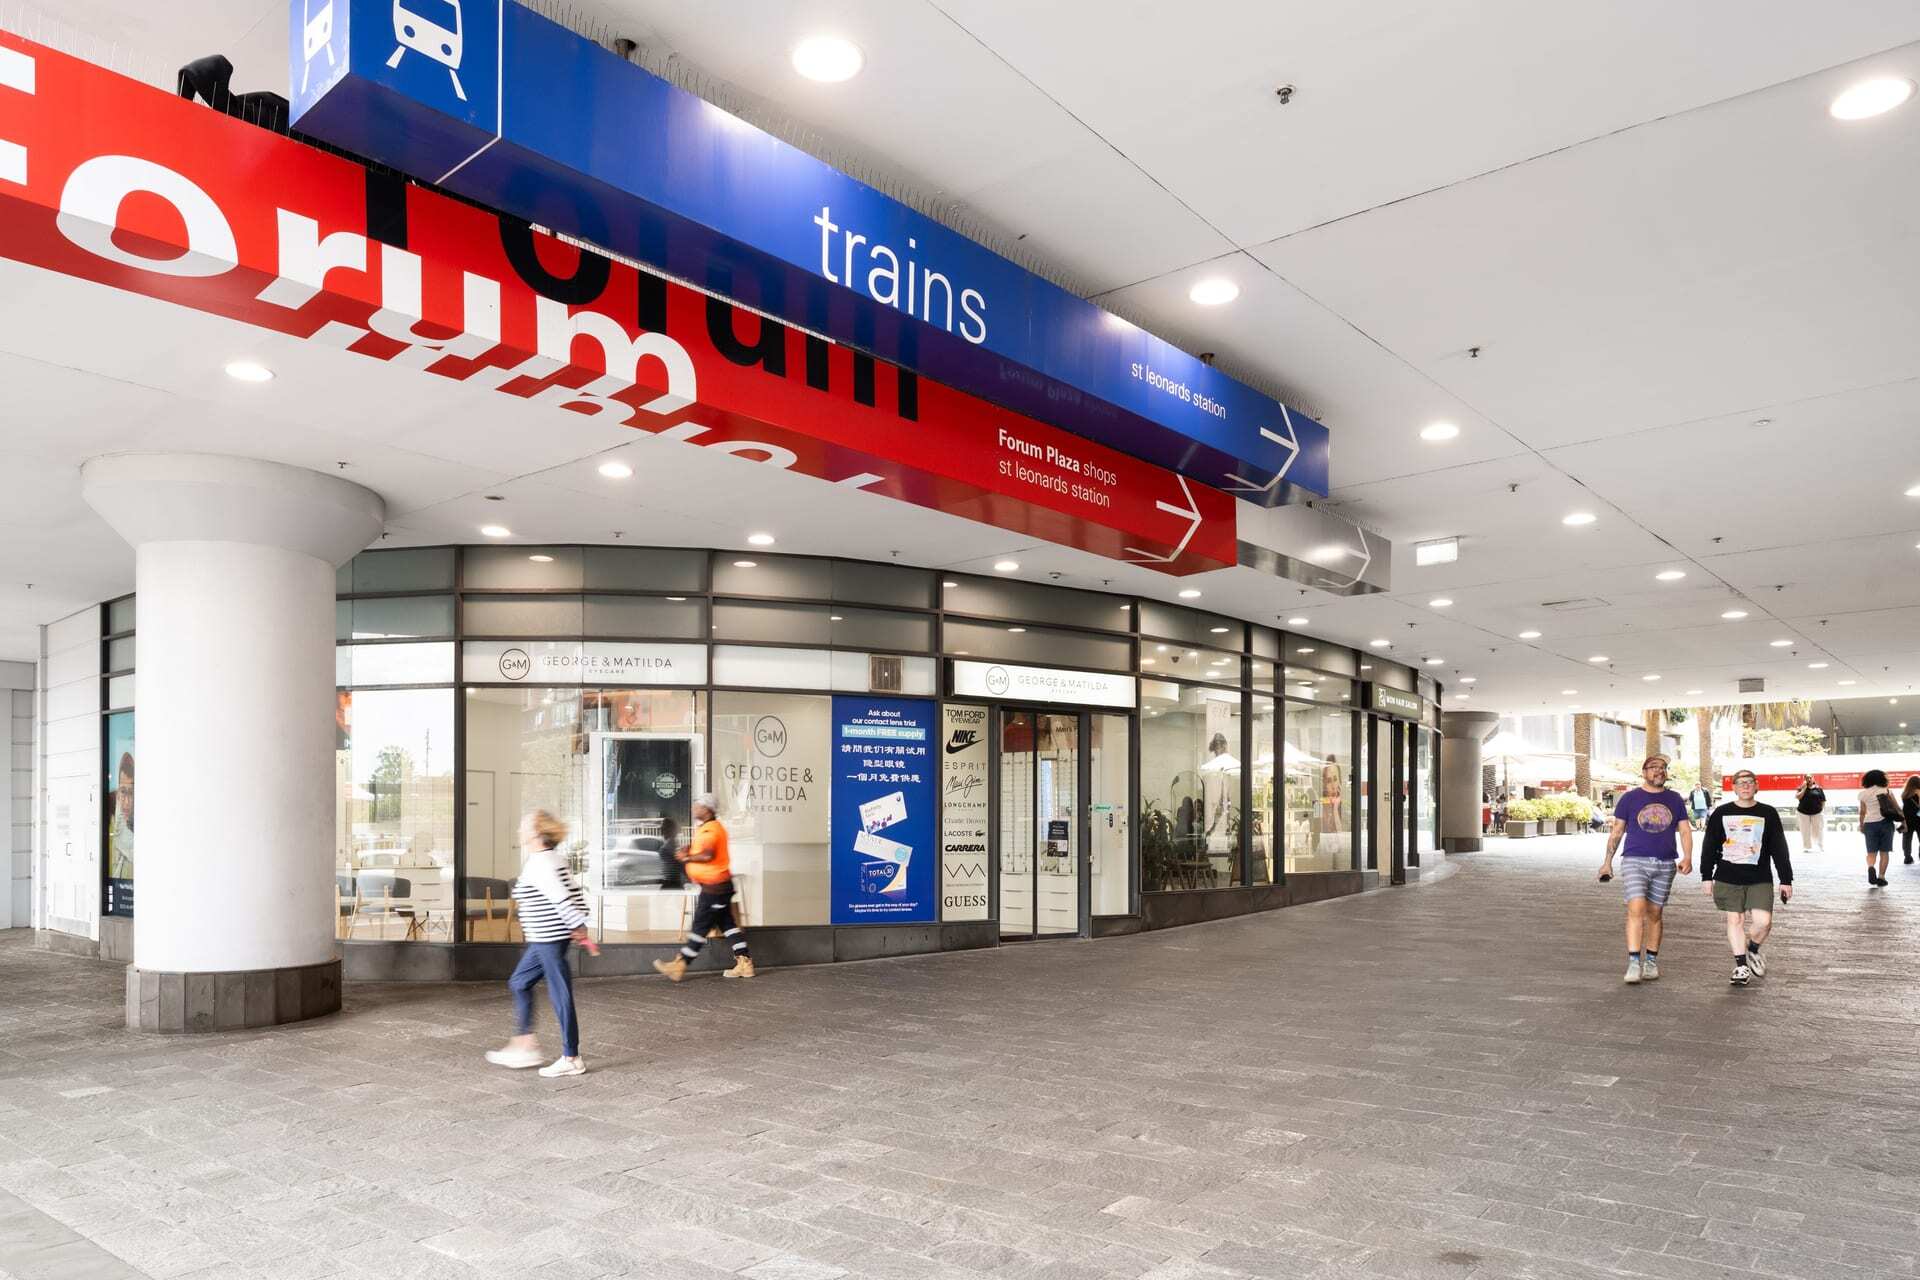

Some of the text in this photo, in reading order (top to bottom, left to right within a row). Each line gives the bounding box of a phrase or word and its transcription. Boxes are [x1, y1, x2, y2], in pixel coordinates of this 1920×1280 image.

[814, 206, 987, 345] trains
[1132, 362, 1226, 420] st leonards station
[998, 428, 1117, 486] Forum Plaza shops
[999, 460, 1110, 508] st leonards station
[502, 658, 527, 670] G&M
[543, 656, 672, 668] GEORGE & MATILDA
[988, 674, 1007, 686] G&M
[1017, 675, 1109, 690] GEORGE & MATILDA
[945, 709, 986, 719] TOM FORD
[758, 729, 783, 744] G&M
[844, 726, 923, 740] 1-month FREE supply
[952, 730, 976, 744] NIKE
[944, 761, 986, 770] ESPRIT
[724, 763, 813, 783] GEORGE &
[746, 804, 793, 813] YECARE
[944, 896, 986, 907] GUESS
